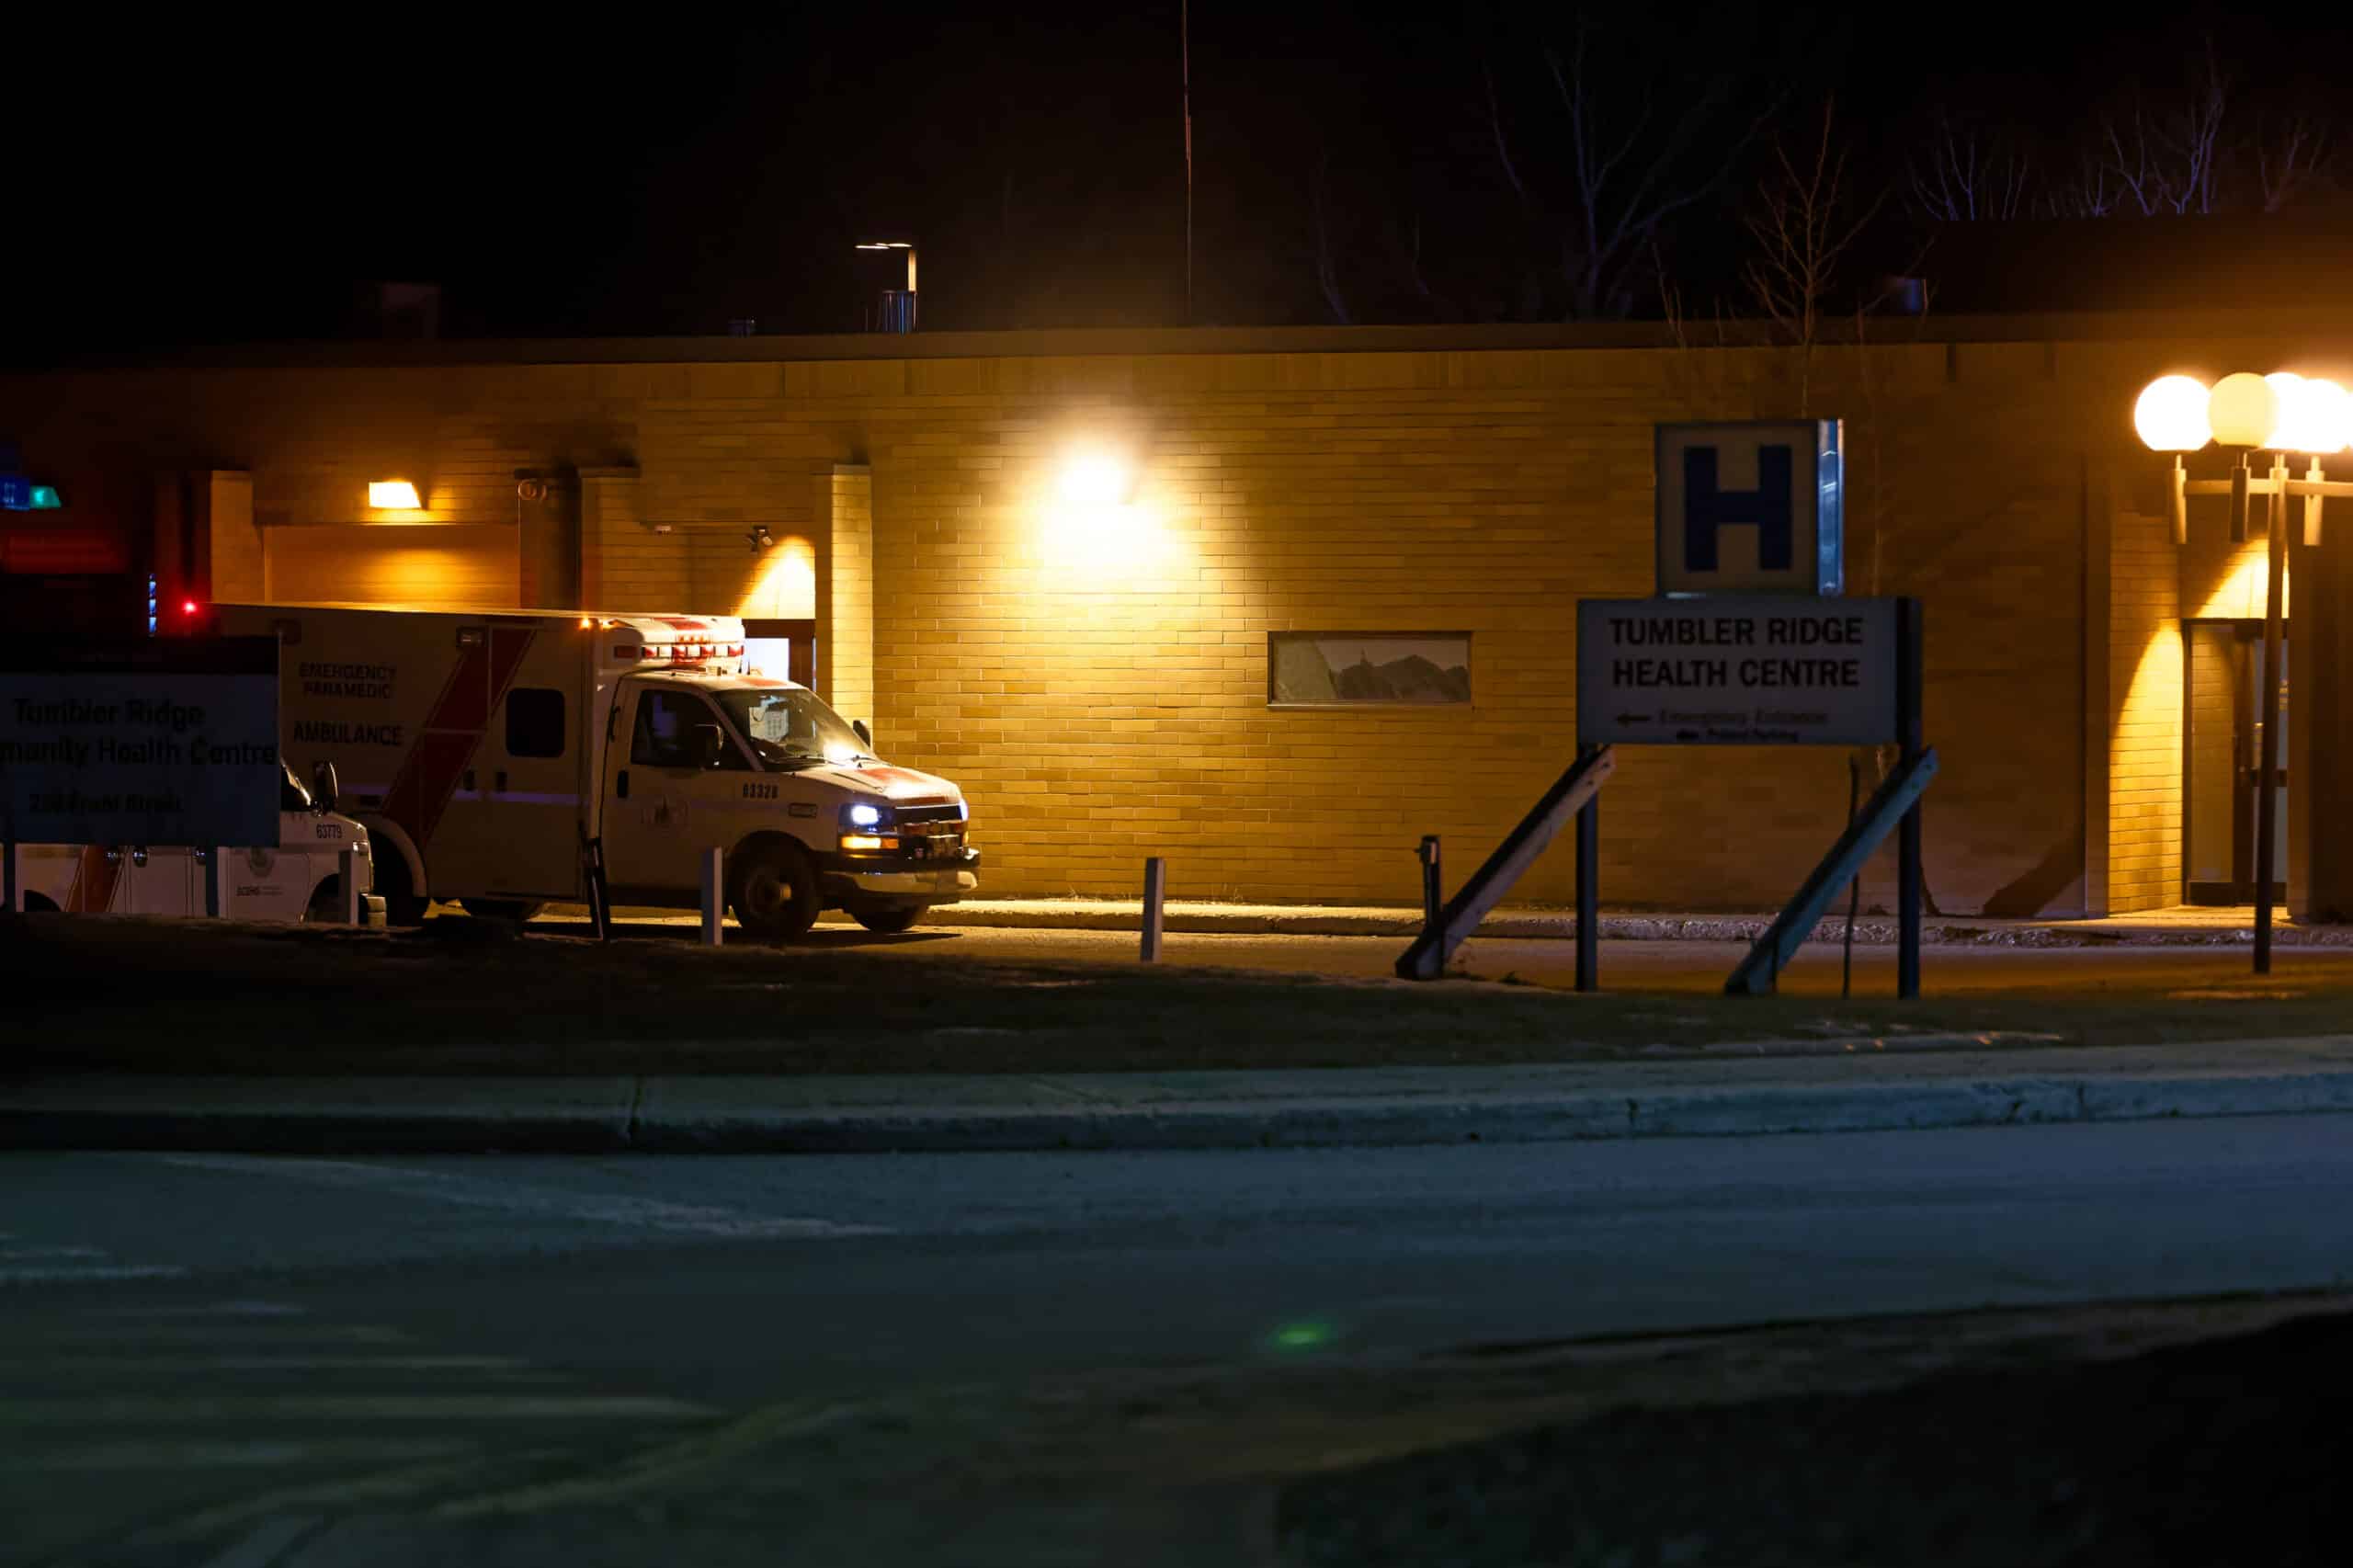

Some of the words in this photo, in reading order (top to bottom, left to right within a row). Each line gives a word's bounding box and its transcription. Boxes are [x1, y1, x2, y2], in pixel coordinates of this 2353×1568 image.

[1685, 445, 1791, 571] H
[1609, 618, 1755, 645] TUMBLER
[1768, 618, 1863, 645] RIDGE
[298, 663, 397, 681] EMERGENCY
[1612, 659, 1727, 687] HEALTH
[1739, 659, 1860, 687] CENTRE
[302, 682, 392, 699] PARAMEDIC
[14, 699, 118, 725] Tumbler
[125, 699, 205, 733] Ridge
[294, 721, 404, 746] AMBULANCE
[97, 735, 181, 765] Health
[190, 735, 277, 765] Centre
